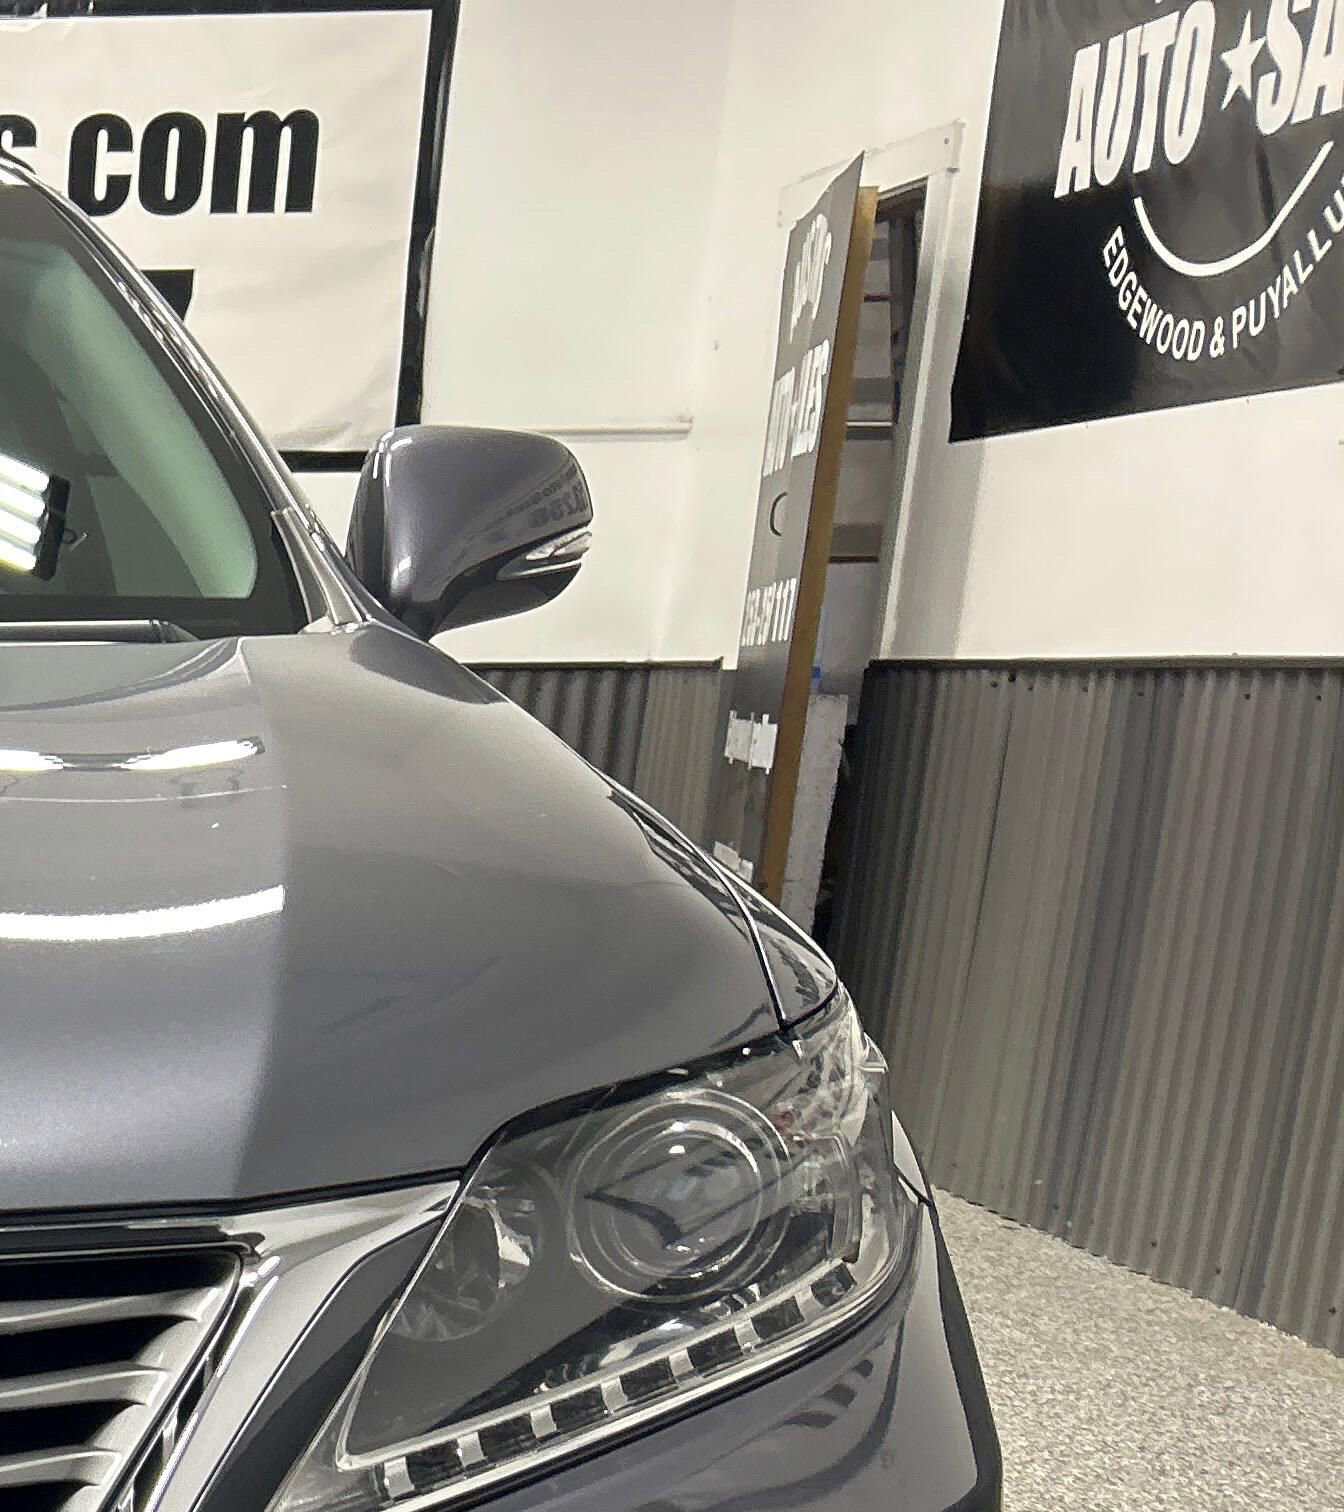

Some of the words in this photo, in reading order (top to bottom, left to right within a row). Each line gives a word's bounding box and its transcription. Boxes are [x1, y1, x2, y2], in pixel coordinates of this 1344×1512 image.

[1053, 0, 1216, 199] AUTO
[1103, 225, 1206, 361] EDGEWOOD
[1209, 315, 1225, 359] &
